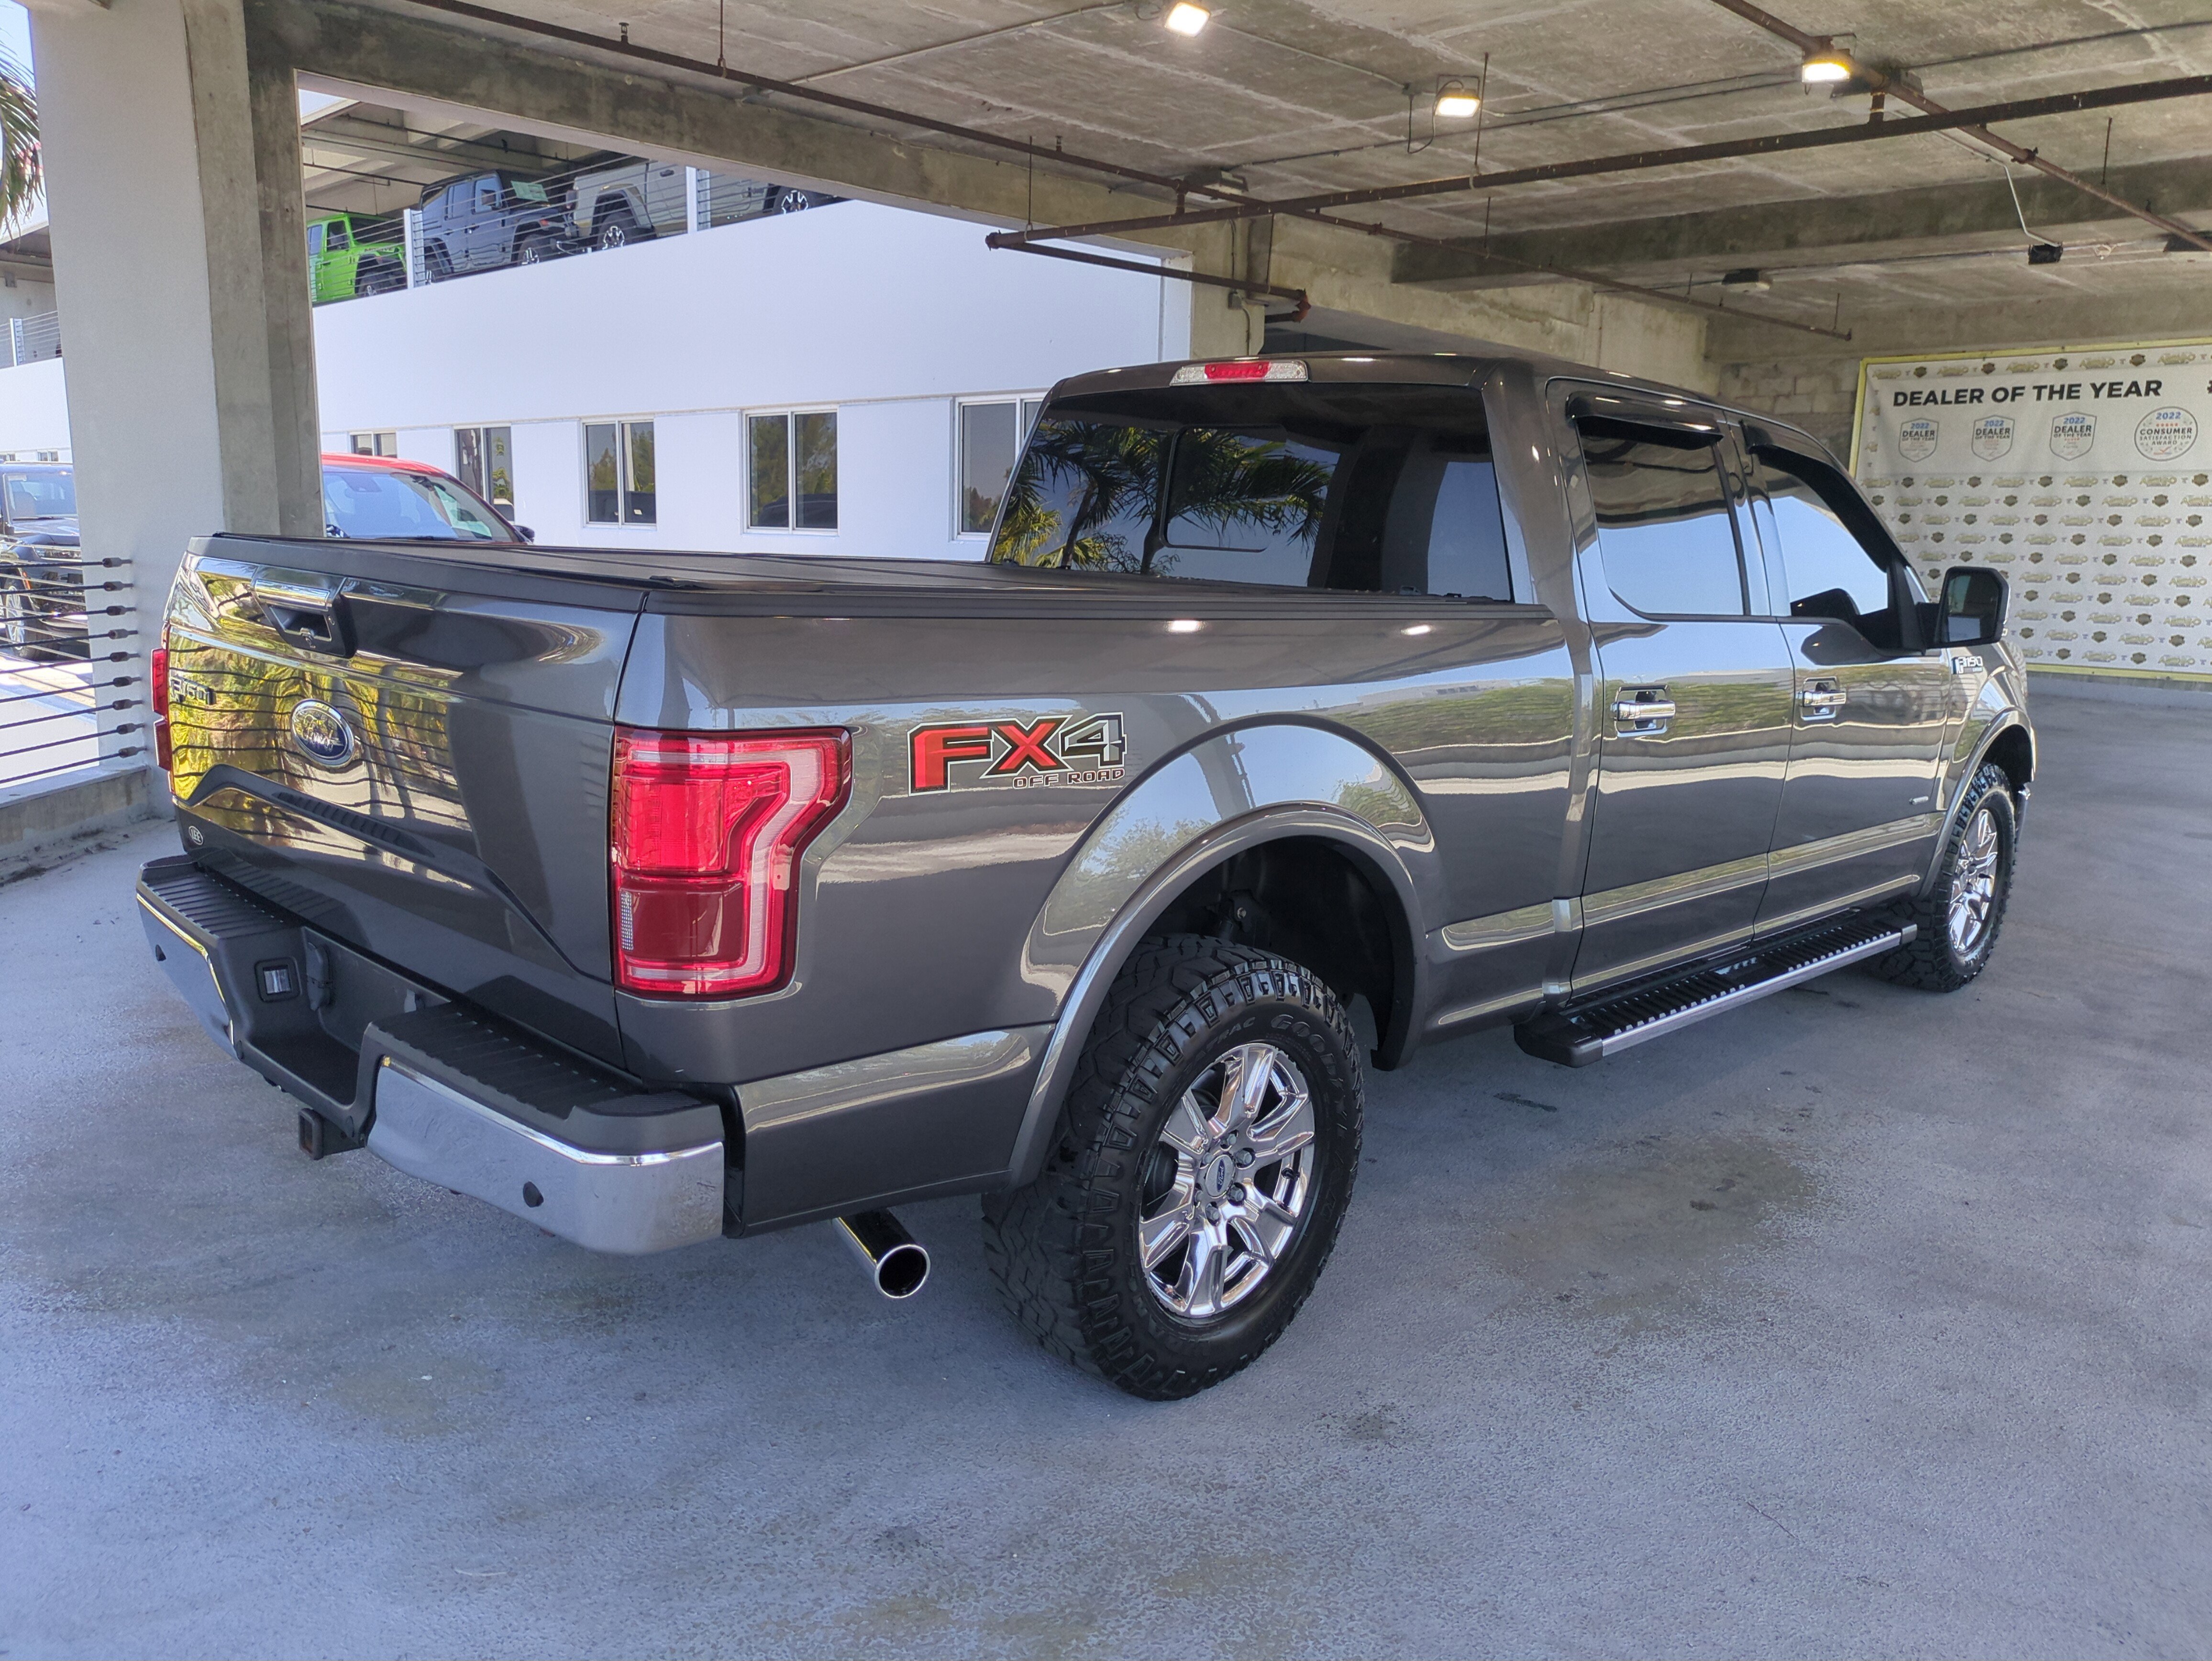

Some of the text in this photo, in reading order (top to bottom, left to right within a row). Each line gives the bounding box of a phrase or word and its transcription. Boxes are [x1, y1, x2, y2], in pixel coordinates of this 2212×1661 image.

[1893, 379, 2163, 407] DEALER OF THE YEAR
[2156, 411, 2181, 420] 2022
[2063, 416, 2086, 425] 2022
[1975, 427, 2010, 436] DEALER
[2054, 424, 2092, 433] DEALER
[2140, 427, 2192, 436] CONSUMER
[907, 711, 1128, 797] FX4
[1012, 768, 1126, 790] OFF ROAD
